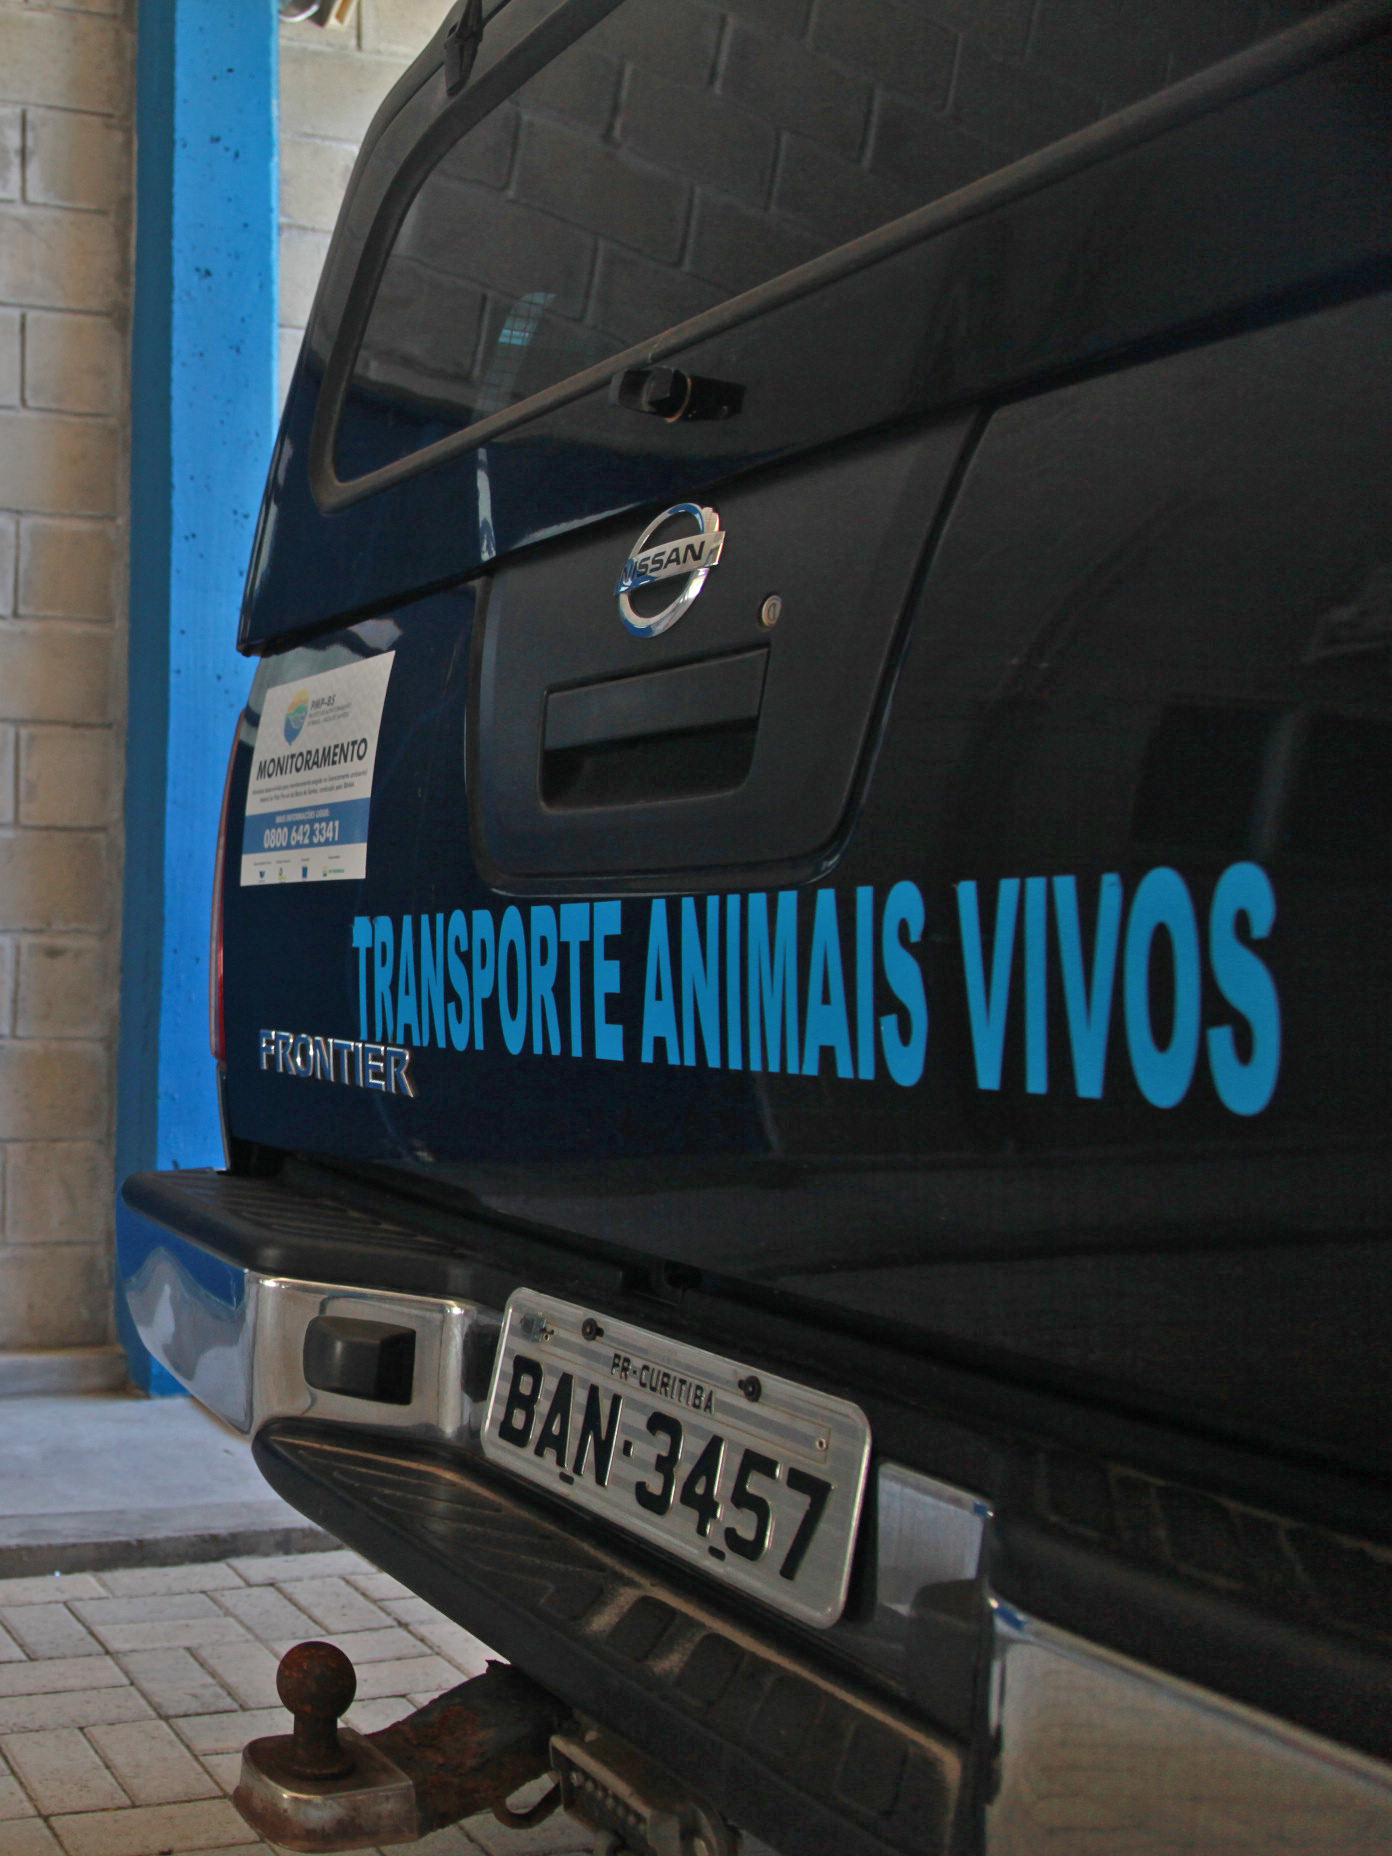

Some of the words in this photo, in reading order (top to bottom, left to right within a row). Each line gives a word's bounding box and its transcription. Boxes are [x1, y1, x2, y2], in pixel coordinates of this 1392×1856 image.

[620, 540, 706, 585] NISSAN
[256, 738, 368, 781] MONITORAMENTO
[264, 827, 288, 849] 0800
[290, 824, 310, 846] 642
[313, 820, 339, 844] 3341
[352, 900, 624, 1061] TRANSPORTE
[641, 880, 929, 1087] ANIMAIS
[955, 861, 1282, 1116] VIVOS
[259, 1029, 415, 1098] FRONTIER
